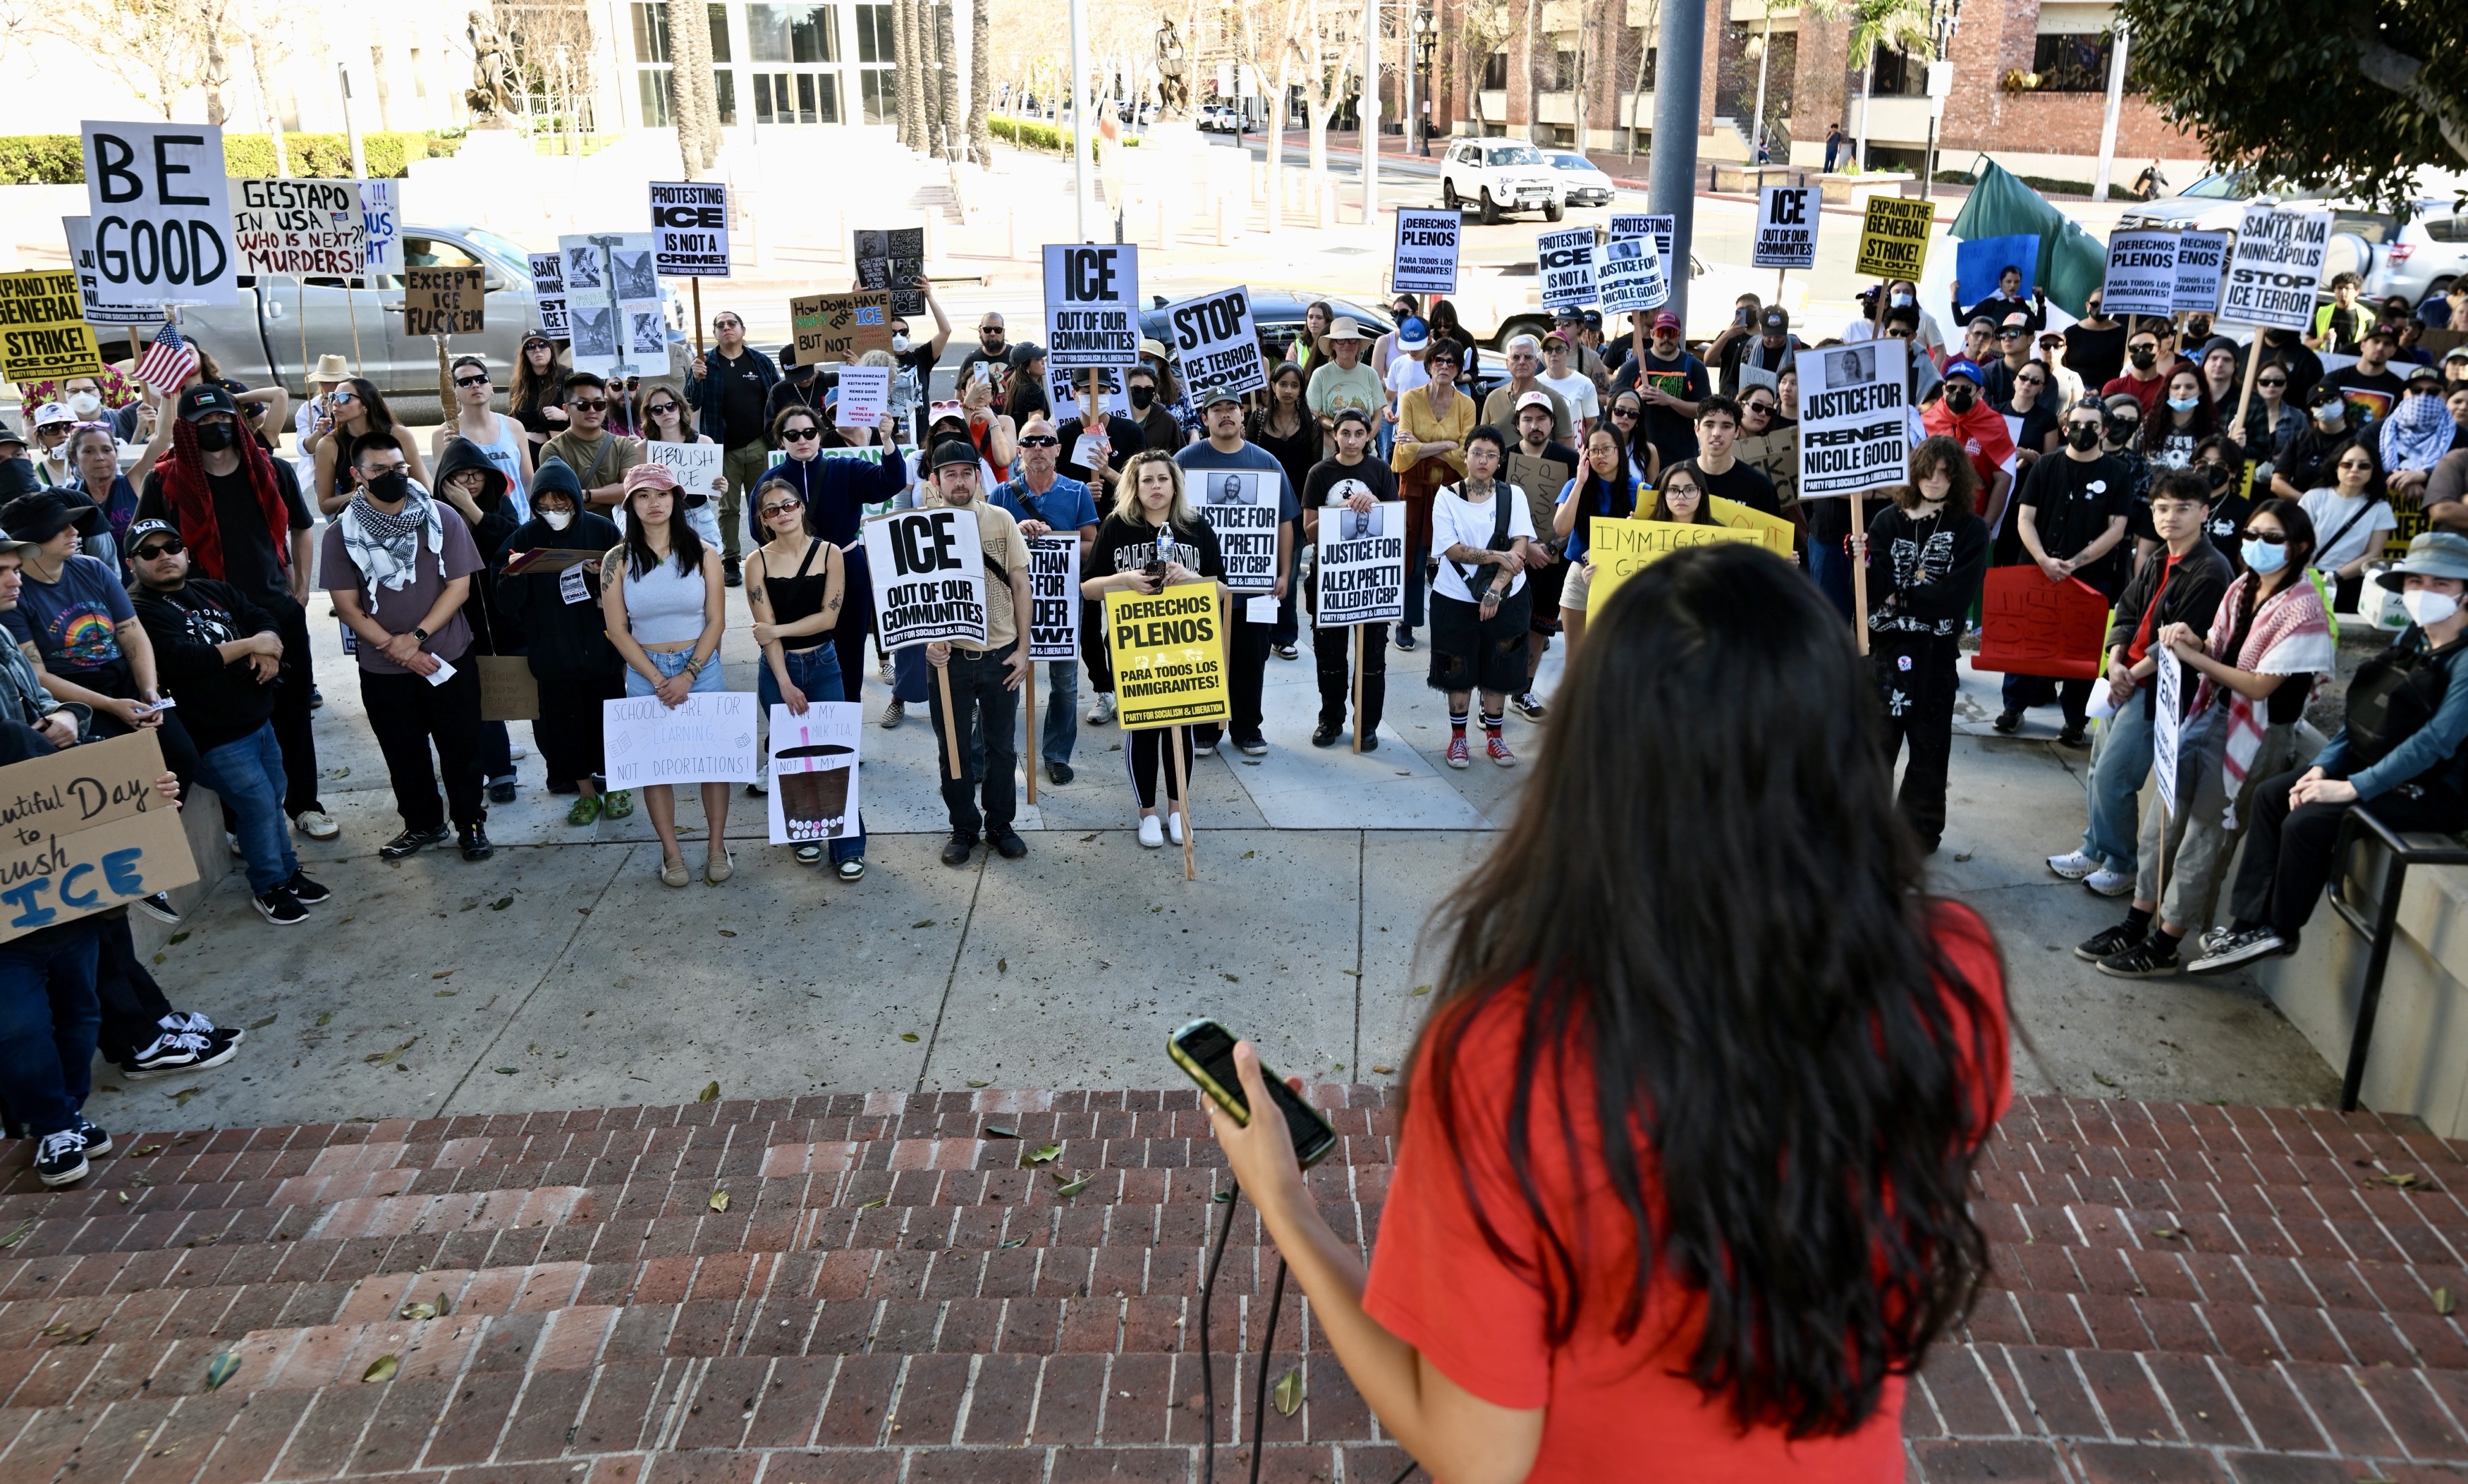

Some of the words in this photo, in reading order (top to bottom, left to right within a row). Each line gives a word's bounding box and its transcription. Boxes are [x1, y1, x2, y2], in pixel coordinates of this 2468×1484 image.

[93, 133, 209, 206] BE
[243, 181, 349, 210] GESTAPO
[652, 186, 723, 204] PROTESTING
[653, 207, 723, 228] ICE
[1770, 190, 1808, 224] ICE
[1870, 199, 1910, 218] EXPAND
[1912, 204, 1931, 220] THE
[2269, 212, 2305, 221] FROM
[235, 212, 262, 232] IN
[276, 210, 324, 231] USA
[1403, 219, 1456, 230] ¡DERECHOS
[1612, 219, 1672, 232] PROTESTING
[1867, 214, 1925, 240] GENERAL
[2243, 215, 2292, 240] SANTA
[2295, 221, 2325, 244] ANA
[236, 231, 279, 251] WHO
[286, 233, 300, 247] IS
[664, 233, 677, 251] IS
[680, 234, 705, 252] NOT
[709, 235, 716, 252] A
[1402, 231, 1455, 246] PLENOS
[1539, 231, 1593, 250] PROTESTING
[1763, 229, 1780, 241] OUT
[1780, 229, 1790, 241] OF
[1791, 229, 1809, 242] OUR
[2114, 240, 2175, 252] ¡DERECHOS
[96, 216, 226, 286] GOOD
[656, 253, 726, 264] CRIME!
[1540, 247, 1592, 270] ICE
[1757, 242, 1812, 255] COMMUNITIES
[1867, 238, 1919, 262] STRIKE!
[2237, 243, 2321, 267] MINNEAPOLIS
[248, 250, 365, 275] MURDERS!!
[1399, 265, 1452, 275] INMIGRANTES!
[1598, 259, 1638, 278] JUSTICE
[1639, 255, 1657, 270] FOR
[1861, 257, 1883, 266] ICE
[1885, 262, 1919, 271] OUT!
[2112, 253, 2173, 268] PLENOS
[51, 275, 78, 295] THE
[409, 270, 481, 290] EXCEPT
[1065, 249, 1118, 301] ICE
[1548, 275, 1557, 288] IS
[1559, 271, 1579, 286] NOT
[1582, 270, 1588, 283] A
[1601, 273, 1661, 293] RENEE
[2233, 269, 2316, 289] STOP
[432, 292, 461, 309] ICE
[575, 293, 605, 307] PARA
[1543, 286, 1596, 300] CRIME!
[1602, 288, 1636, 305] NICOLE
[1637, 282, 1662, 298] GOOD
[2107, 288, 2169, 298] INMIGRANTES!
[2228, 285, 2252, 306] ICE
[2256, 288, 2311, 314] TERROR
[794, 302, 818, 316] How
[854, 294, 887, 307] HAVE
[796, 314, 829, 329] MONEY
[829, 309, 853, 330] FOR
[854, 307, 885, 325] ICE
[1057, 312, 1082, 330] OUT
[1084, 312, 1099, 330] OF
[1101, 312, 1126, 330] OUR
[1173, 293, 1246, 350] STOP
[5, 327, 87, 357] STRIKE!
[799, 334, 821, 350] BUT
[825, 337, 853, 352] NOT
[1051, 331, 1135, 350] COMMUNITIES
[6, 357, 39, 368] ICE
[45, 353, 96, 365] OUT!
[1185, 357, 1206, 379] ICE
[1206, 343, 1257, 372] TERROR
[1190, 362, 1260, 393] NOW!
[1804, 388, 1867, 421] JUSTICE
[1869, 383, 1901, 410] FOR
[1804, 421, 1902, 448] RENEE
[653, 445, 715, 467] ABOLISH
[1804, 448, 1860, 474] NICOLE
[1864, 440, 1902, 467] GOOD
[678, 469, 700, 487] CE
[1197, 506, 1245, 527] USTICE
[1247, 507, 1276, 528] FOR
[888, 513, 962, 577] ICE
[1225, 534, 1274, 555] PRETTI
[1321, 540, 1373, 565] JUSTICE
[1375, 538, 1401, 558] FOR
[1230, 556, 1245, 573] BY
[1247, 556, 1271, 573] CBP
[1036, 575, 1065, 596] FOR
[1321, 570, 1355, 591] ALEX
[1357, 565, 1400, 589] PRETTI
[887, 584, 917, 608] OUT
[920, 582, 939, 603] OF
[941, 580, 973, 601] OUR
[1324, 591, 1360, 609] KILLED
[1362, 589, 1374, 608] BY
[1376, 587, 1398, 604] CBP
[882, 601, 983, 631] COMMUNITIES
[1115, 596, 1211, 624] ¡DERECHOS
[1117, 618, 1214, 650] PLENOS
[1120, 668, 1152, 682] PARA
[1157, 663, 1192, 677] TODOS
[1196, 661, 1218, 674] LOS
[1123, 675, 1219, 698] INMIGRANTES!
[613, 701, 667, 721] SCHOOLS
[681, 697, 702, 716] ARE
[717, 697, 740, 716] FOR
[819, 705, 836, 719] MY
[1125, 713, 1143, 722] PARTY
[1143, 711, 1154, 719] FOR
[1154, 709, 1183, 719] SOCIALISM
[1192, 704, 1223, 714] LIBERATION
[654, 725, 715, 744] LEARNING,
[812, 724, 829, 737] MILK
[836, 723, 853, 736] TEA.
[618, 763, 639, 780] NOT
[654, 756, 749, 776] DEPORTATIONS!
[780, 760, 798, 772] NOT
[821, 758, 836, 770] MY
[67, 777, 149, 821] Day
[13, 828, 40, 846] to
[1, 847, 147, 928] ICE
